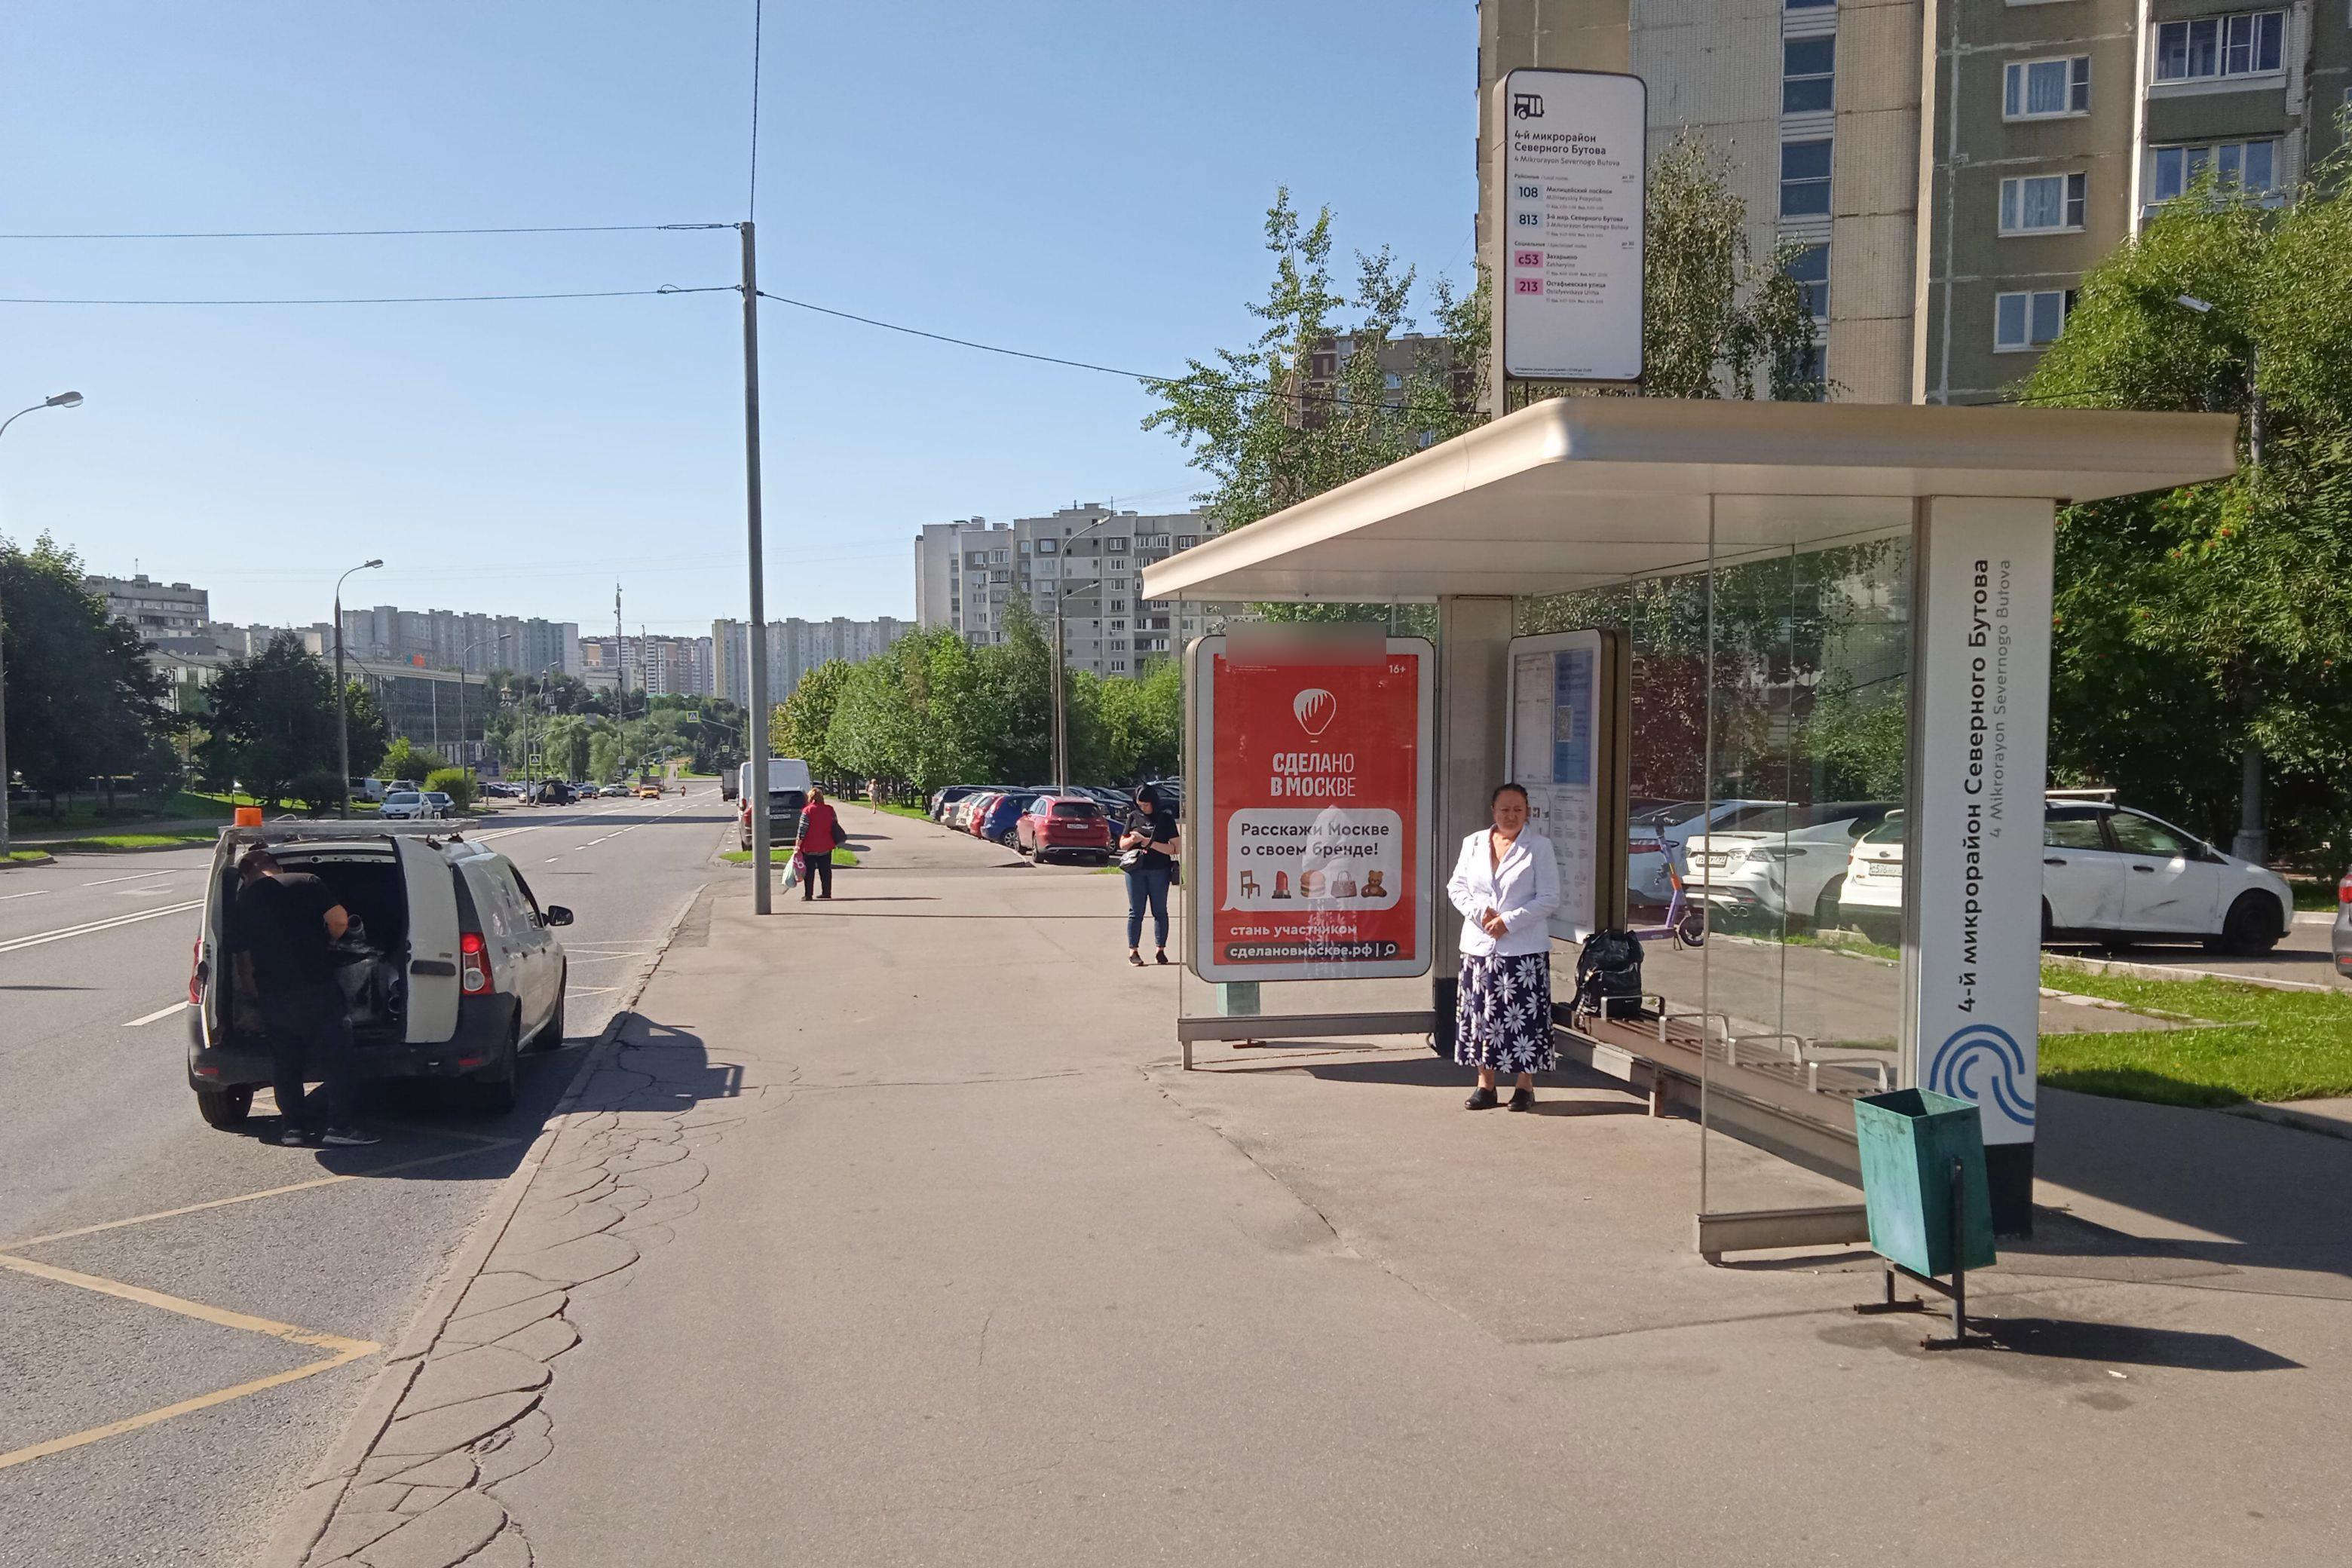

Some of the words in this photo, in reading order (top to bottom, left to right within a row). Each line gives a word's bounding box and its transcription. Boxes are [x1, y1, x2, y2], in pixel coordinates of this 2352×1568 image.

[1514, 130, 1530, 139] 4-й
[1533, 132, 1597, 143] микрорайон
[1514, 142, 1569, 154] Северного
[1572, 144, 1606, 156] Бутова
[1521, 156, 1559, 164] Mikrorayon
[1560, 158, 1596, 167] Severnogo
[1519, 187, 1538, 198] 108
[1519, 214, 1538, 225] 813
[1519, 281, 1538, 292] 213
[1996, 560, 2011, 618] Butova
[1968, 560, 1991, 647] Бутова
[1389, 664, 1406, 674] 16+
[1994, 625, 2011, 715] Severnogo
[1965, 657, 1988, 795] Северного
[1272, 752, 1354, 776] СДЕЛАНО
[1990, 721, 2007, 820] Mikrorayon
[1270, 776, 1282, 797] В
[1286, 776, 1356, 797] МОСКВЕ
[1241, 822, 1322, 836] Расскажи
[1328, 822, 1389, 835] Москве
[1989, 828, 2001, 838] 4
[1241, 847, 1251, 856] о
[1256, 846, 1306, 856] своем
[1312, 842, 1378, 858] бренде!
[1962, 804, 1983, 964] микрорайон
[1230, 926, 1270, 936] стань
[1273, 925, 1357, 939] участником
[1230, 944, 1372, 958] сделановмоскве.рф
[1958, 972, 1976, 1013] 4-й
